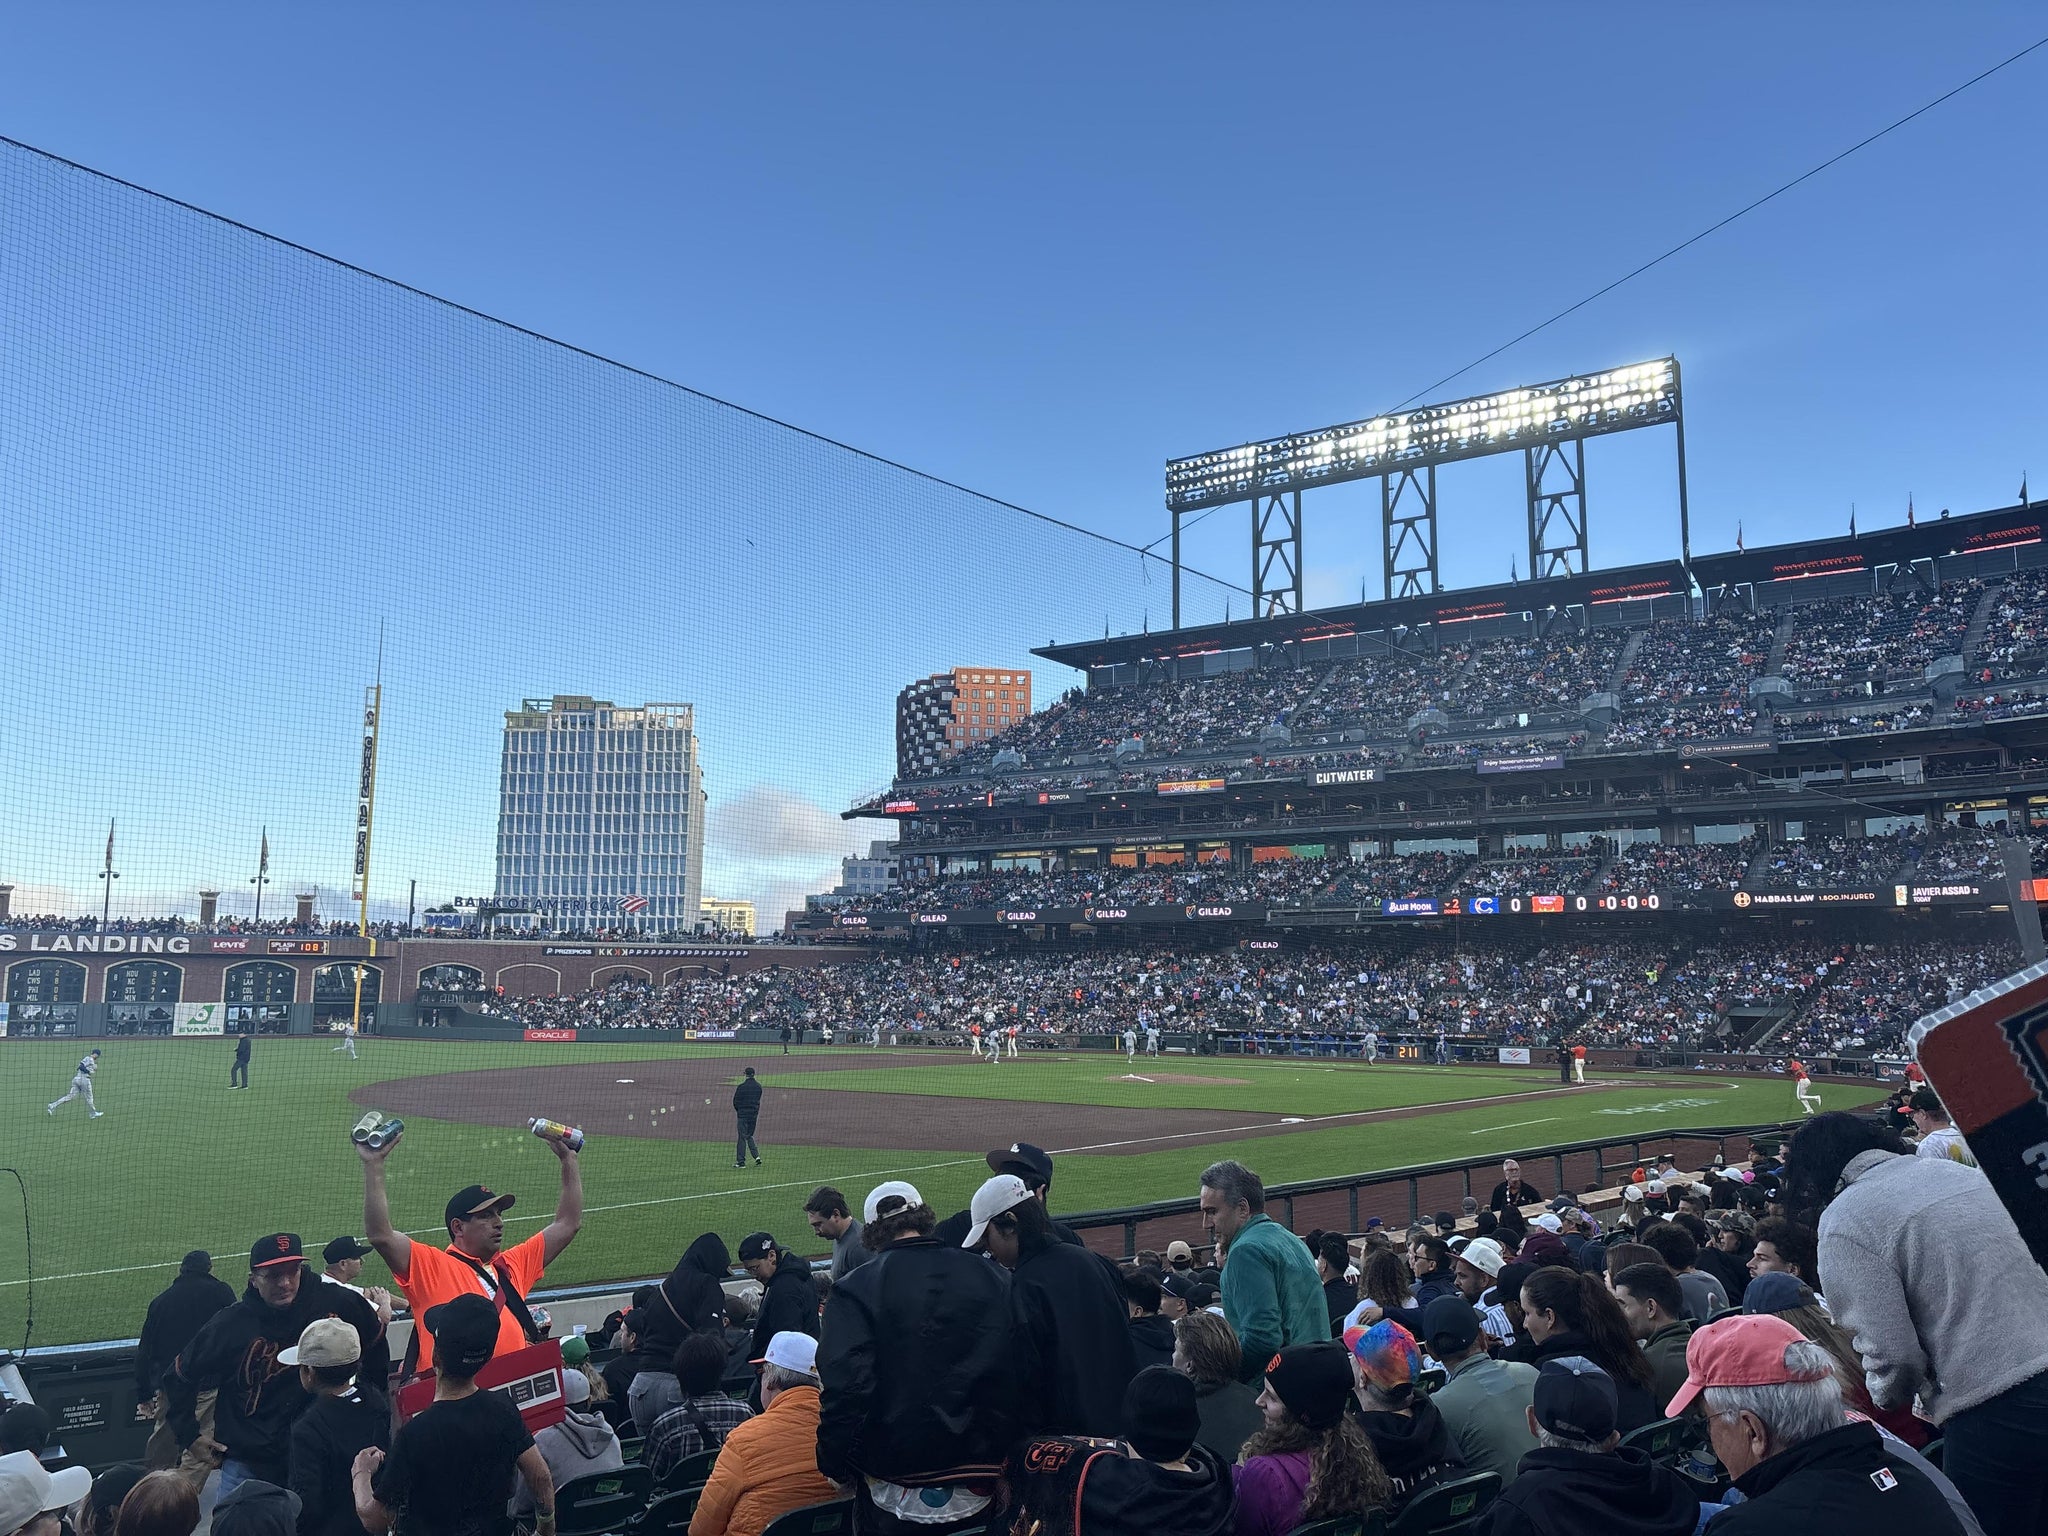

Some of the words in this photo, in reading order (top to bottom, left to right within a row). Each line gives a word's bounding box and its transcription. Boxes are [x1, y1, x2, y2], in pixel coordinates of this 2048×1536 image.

[361, 736, 373, 799] CHIKIN
[1316, 769, 1374, 784] CUTWATER
[355, 831, 367, 875] FARE
[1912, 887, 1941, 897] JAVIER
[1942, 885, 1970, 896] ASSAD
[1452, 898, 1459, 909] 2
[1577, 896, 1587, 911] 0
[1599, 899, 1605, 907] B
[1606, 896, 1617, 910] 0
[1621, 899, 1626, 907] S
[1627, 895, 1638, 910] 0
[1648, 895, 1659, 909] 0
[1754, 895, 1792, 903] HABBAS
[1793, 894, 1815, 902] LAW
[454, 896, 502, 909] BANK
[508, 897, 528, 910] OF
[534, 898, 611, 912] AMERICA
[1511, 898, 1521, 912] 0
[1007, 911, 1036, 921] GILEAD
[1096, 909, 1127, 919] GILEAD
[1198, 907, 1232, 917] GILEAD
[425, 914, 461, 929] VISA
[842, 916, 868, 925] GILEAD
[920, 914, 948, 923] GILEAD
[30, 934, 191, 954] LANDING
[300, 943, 319, 952] 108
[1250, 940, 1279, 949] GILEAD
[28, 969, 41, 977] LAD
[27, 977, 41, 985] CWS
[531, 1031, 569, 1039] ORACLE
[686, 1031, 696, 1039] THE
[697, 1031, 716, 1039] SPORTS
